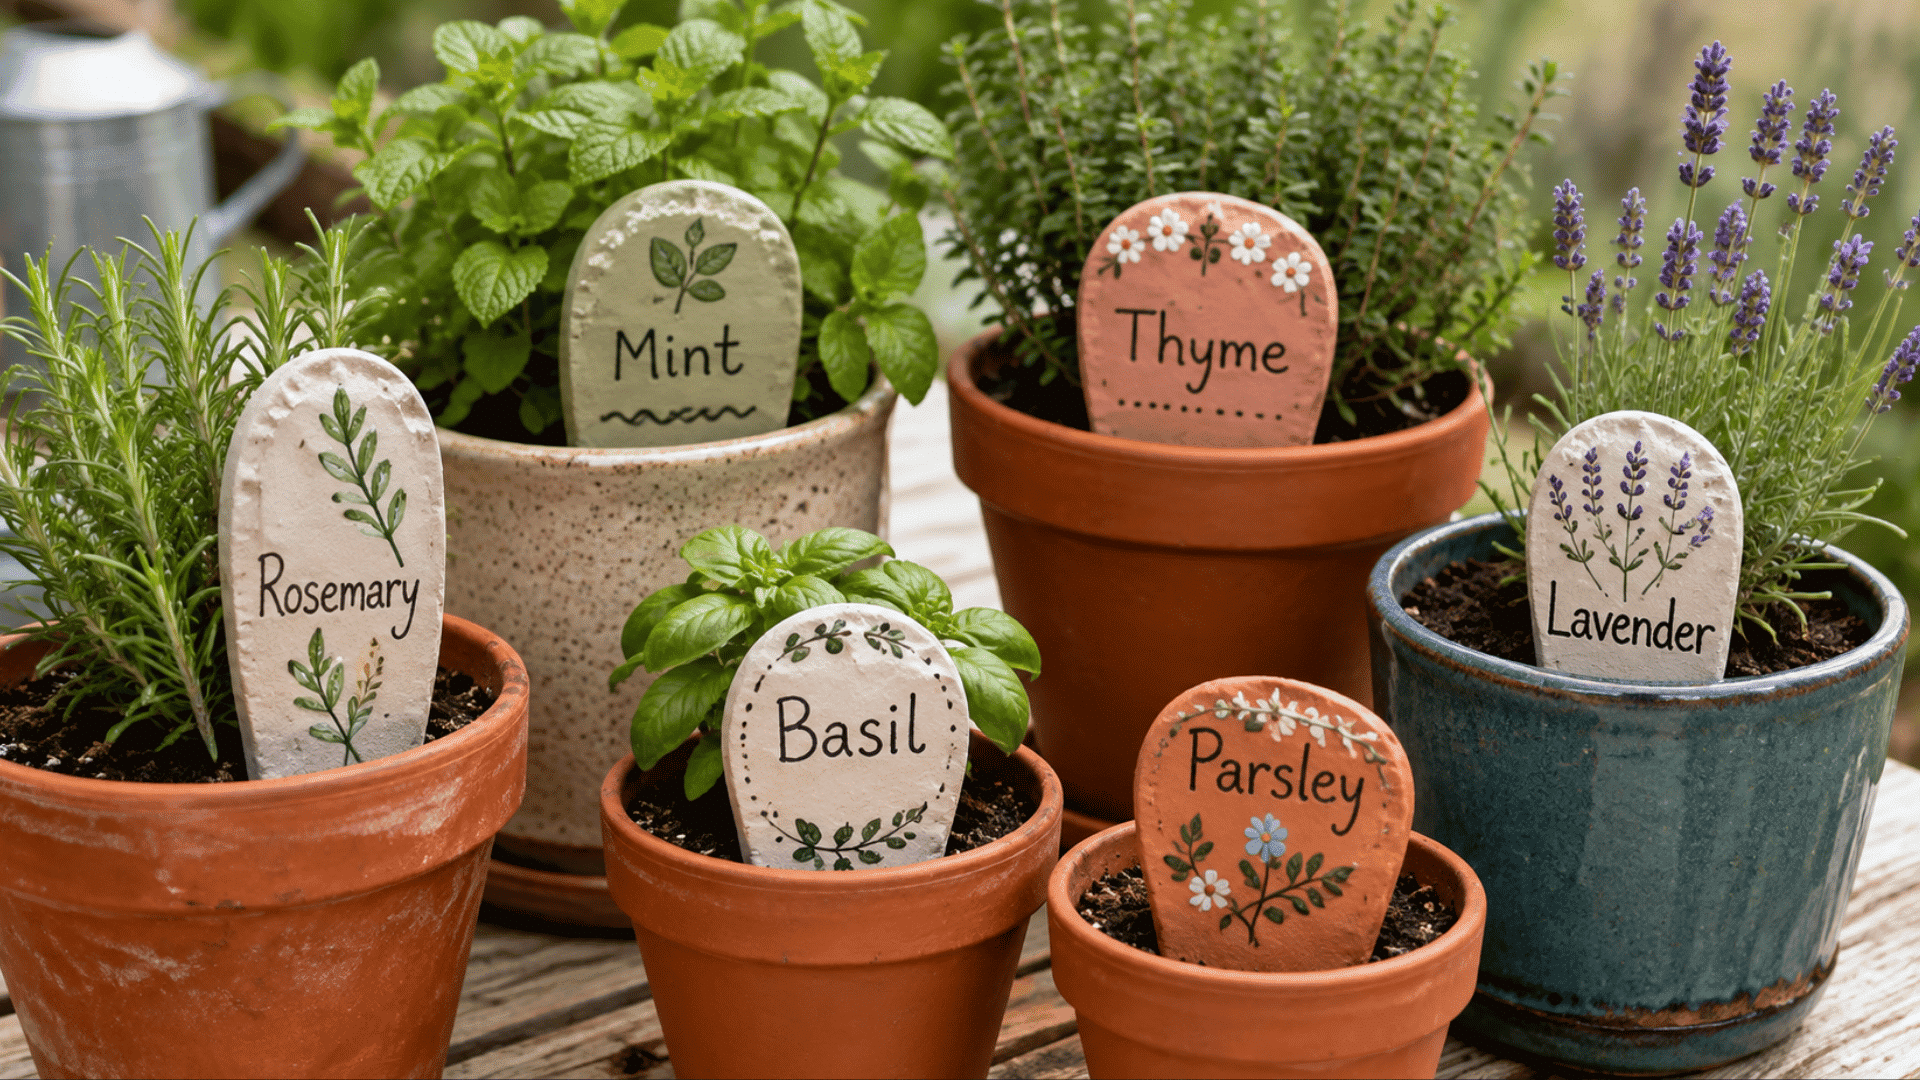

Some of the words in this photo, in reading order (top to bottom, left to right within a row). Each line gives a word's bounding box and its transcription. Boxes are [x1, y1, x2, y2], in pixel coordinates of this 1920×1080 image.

[613, 324, 745, 382] Mint
[1114, 307, 1289, 395] Thyme
[257, 551, 420, 641] Rosemary
[1547, 579, 1717, 655] Lavender
[776, 692, 926, 763] Basil
[1187, 727, 1366, 837] Parsley
